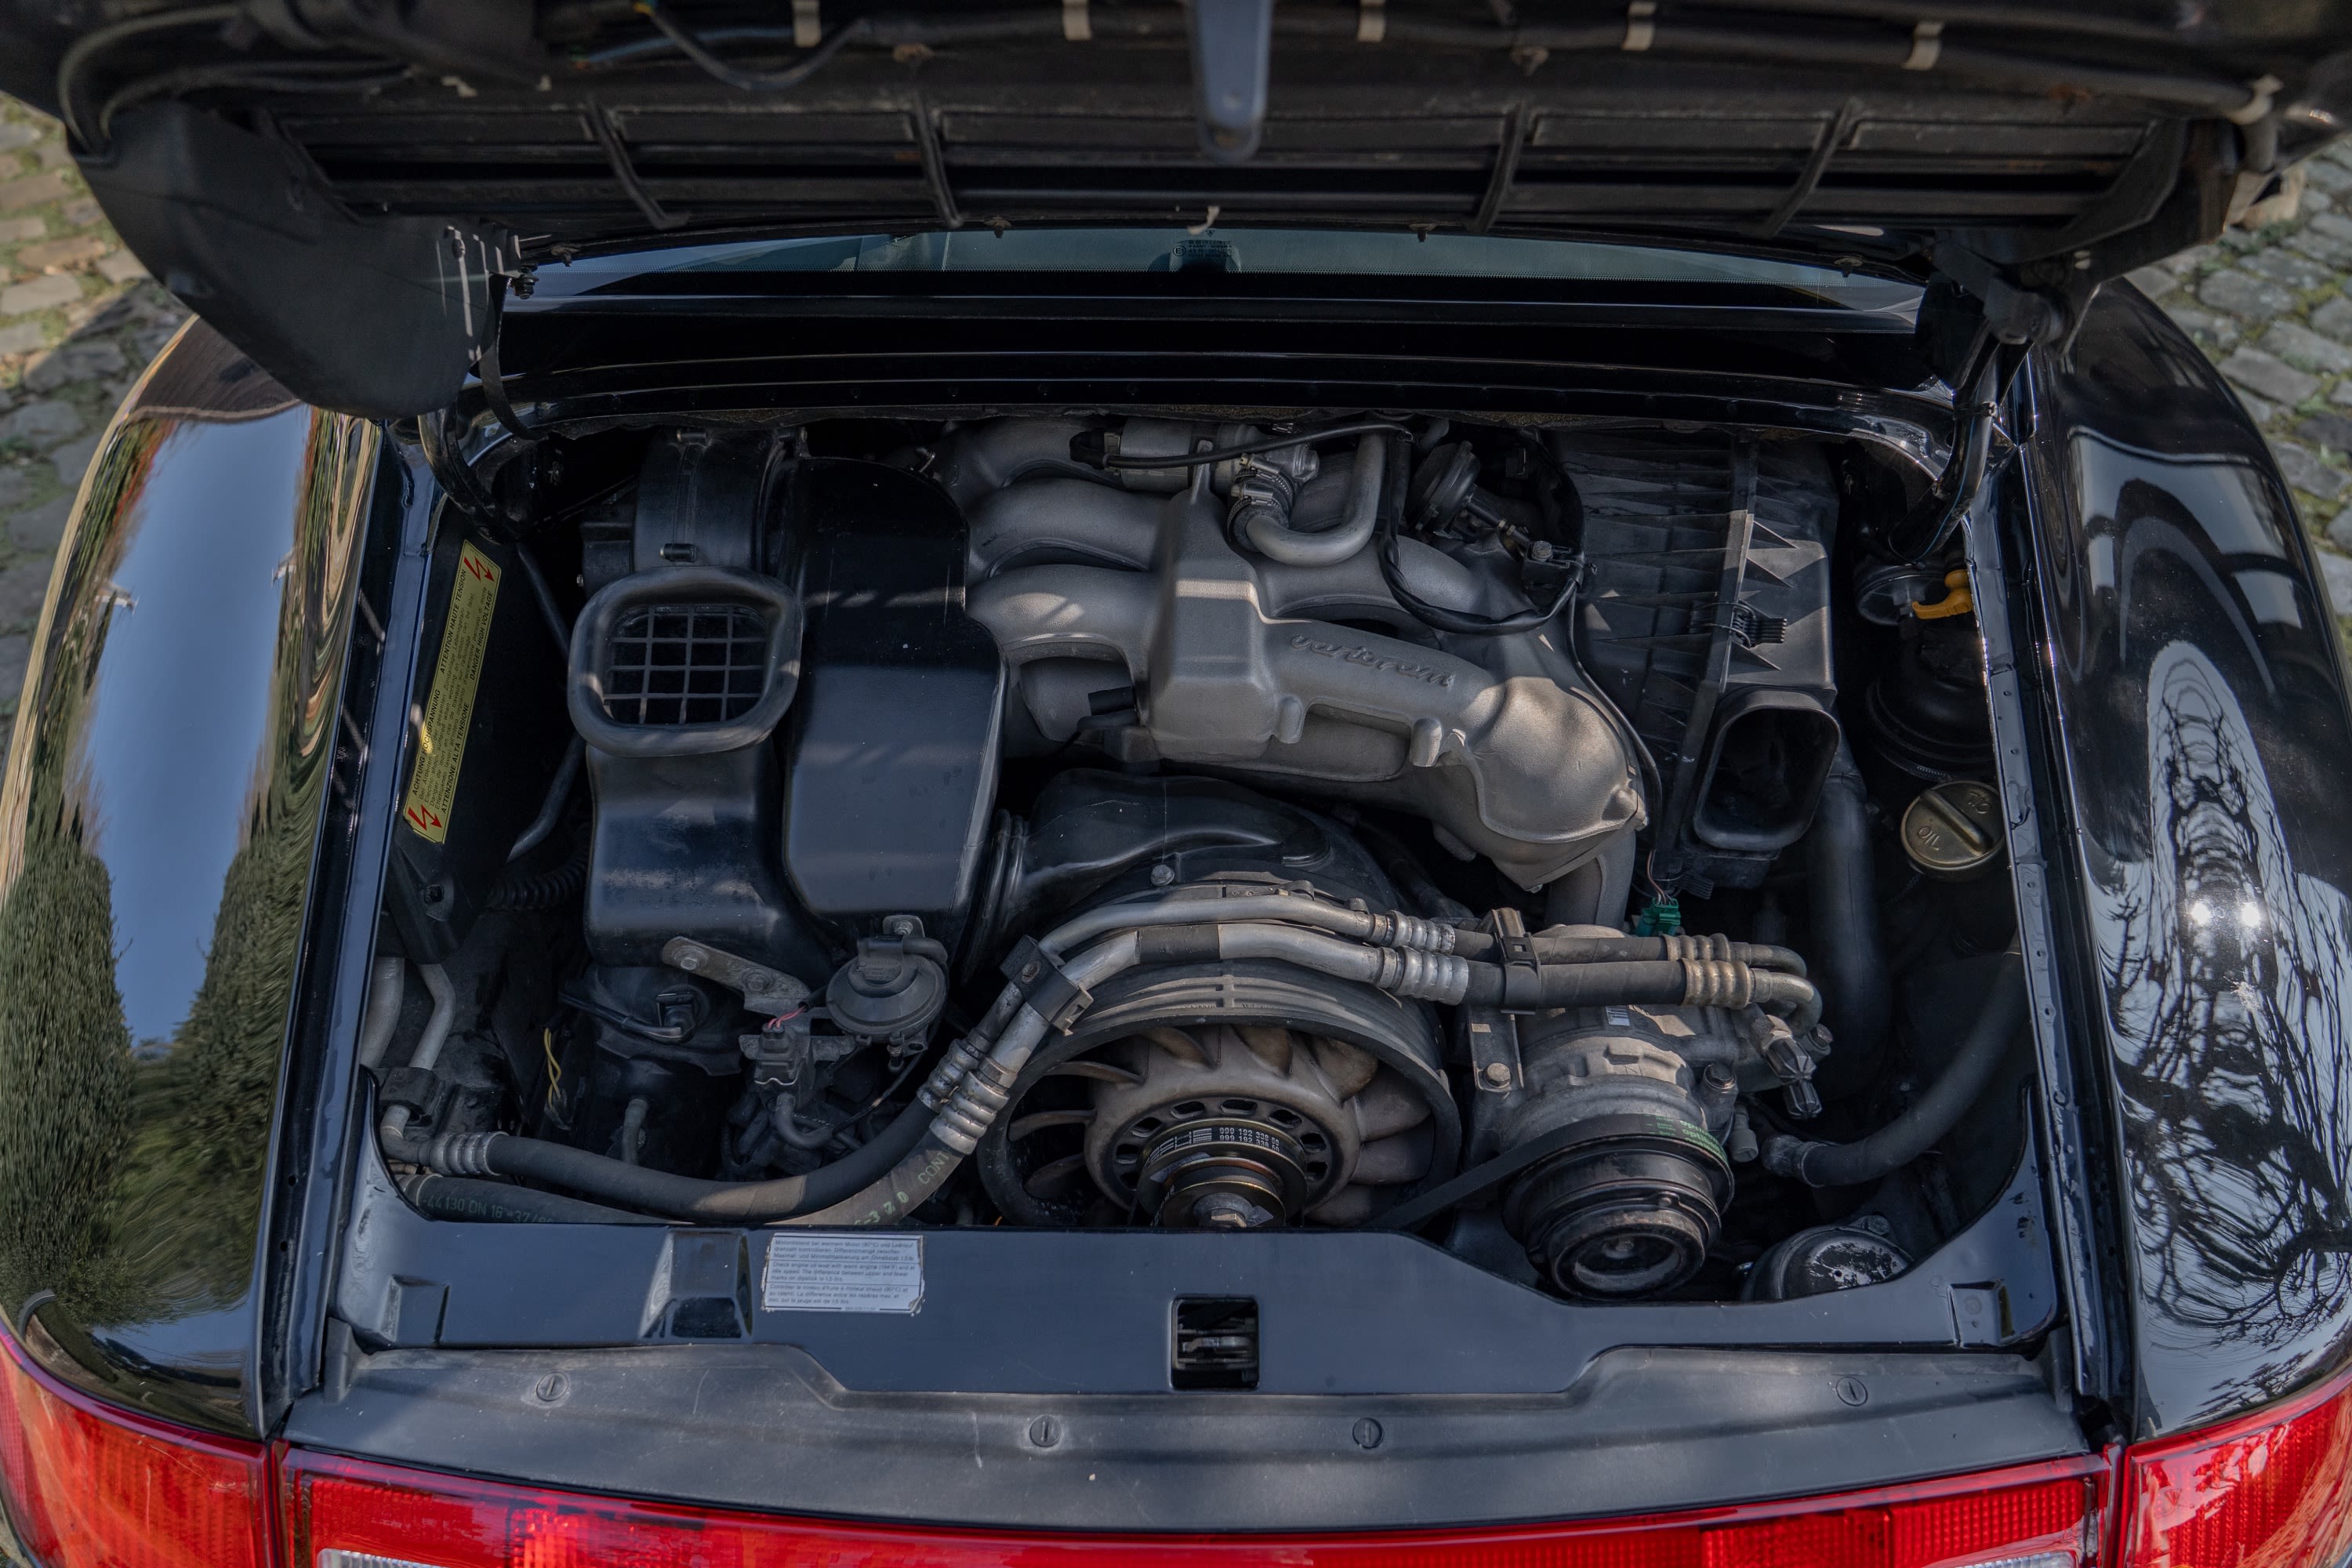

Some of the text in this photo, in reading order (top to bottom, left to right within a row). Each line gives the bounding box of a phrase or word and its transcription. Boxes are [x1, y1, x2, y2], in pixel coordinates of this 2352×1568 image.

[412, 568, 466, 796] ACHTUNG HOCHSPANNUNG ATTENTION HAUTE TENSION
[424, 776, 434, 804] Electric
[436, 723, 445, 751] suffered
[447, 673, 456, 699] working
[453, 661, 459, 672] on
[456, 635, 465, 660] ignition
[435, 692, 446, 726] gesamten
[441, 763, 456, 815] ATTENZIONE
[452, 741, 460, 764] ALTA
[456, 701, 469, 741] TENSIONE
[470, 646, 481, 681] DANGER
[481, 590, 493, 626] VOLTAGE
[430, 781, 439, 807] Danger
[436, 768, 442, 779] de
[448, 710, 455, 720] de
[434, 770, 447, 811] Effettuando
[456, 686, 466, 716] impianto
[1918, 826, 1940, 851] OIL
[1238, 1128, 1253, 1138] 192
[1271, 1137, 1279, 1146] 50
[468, 1200, 487, 1216] DN
